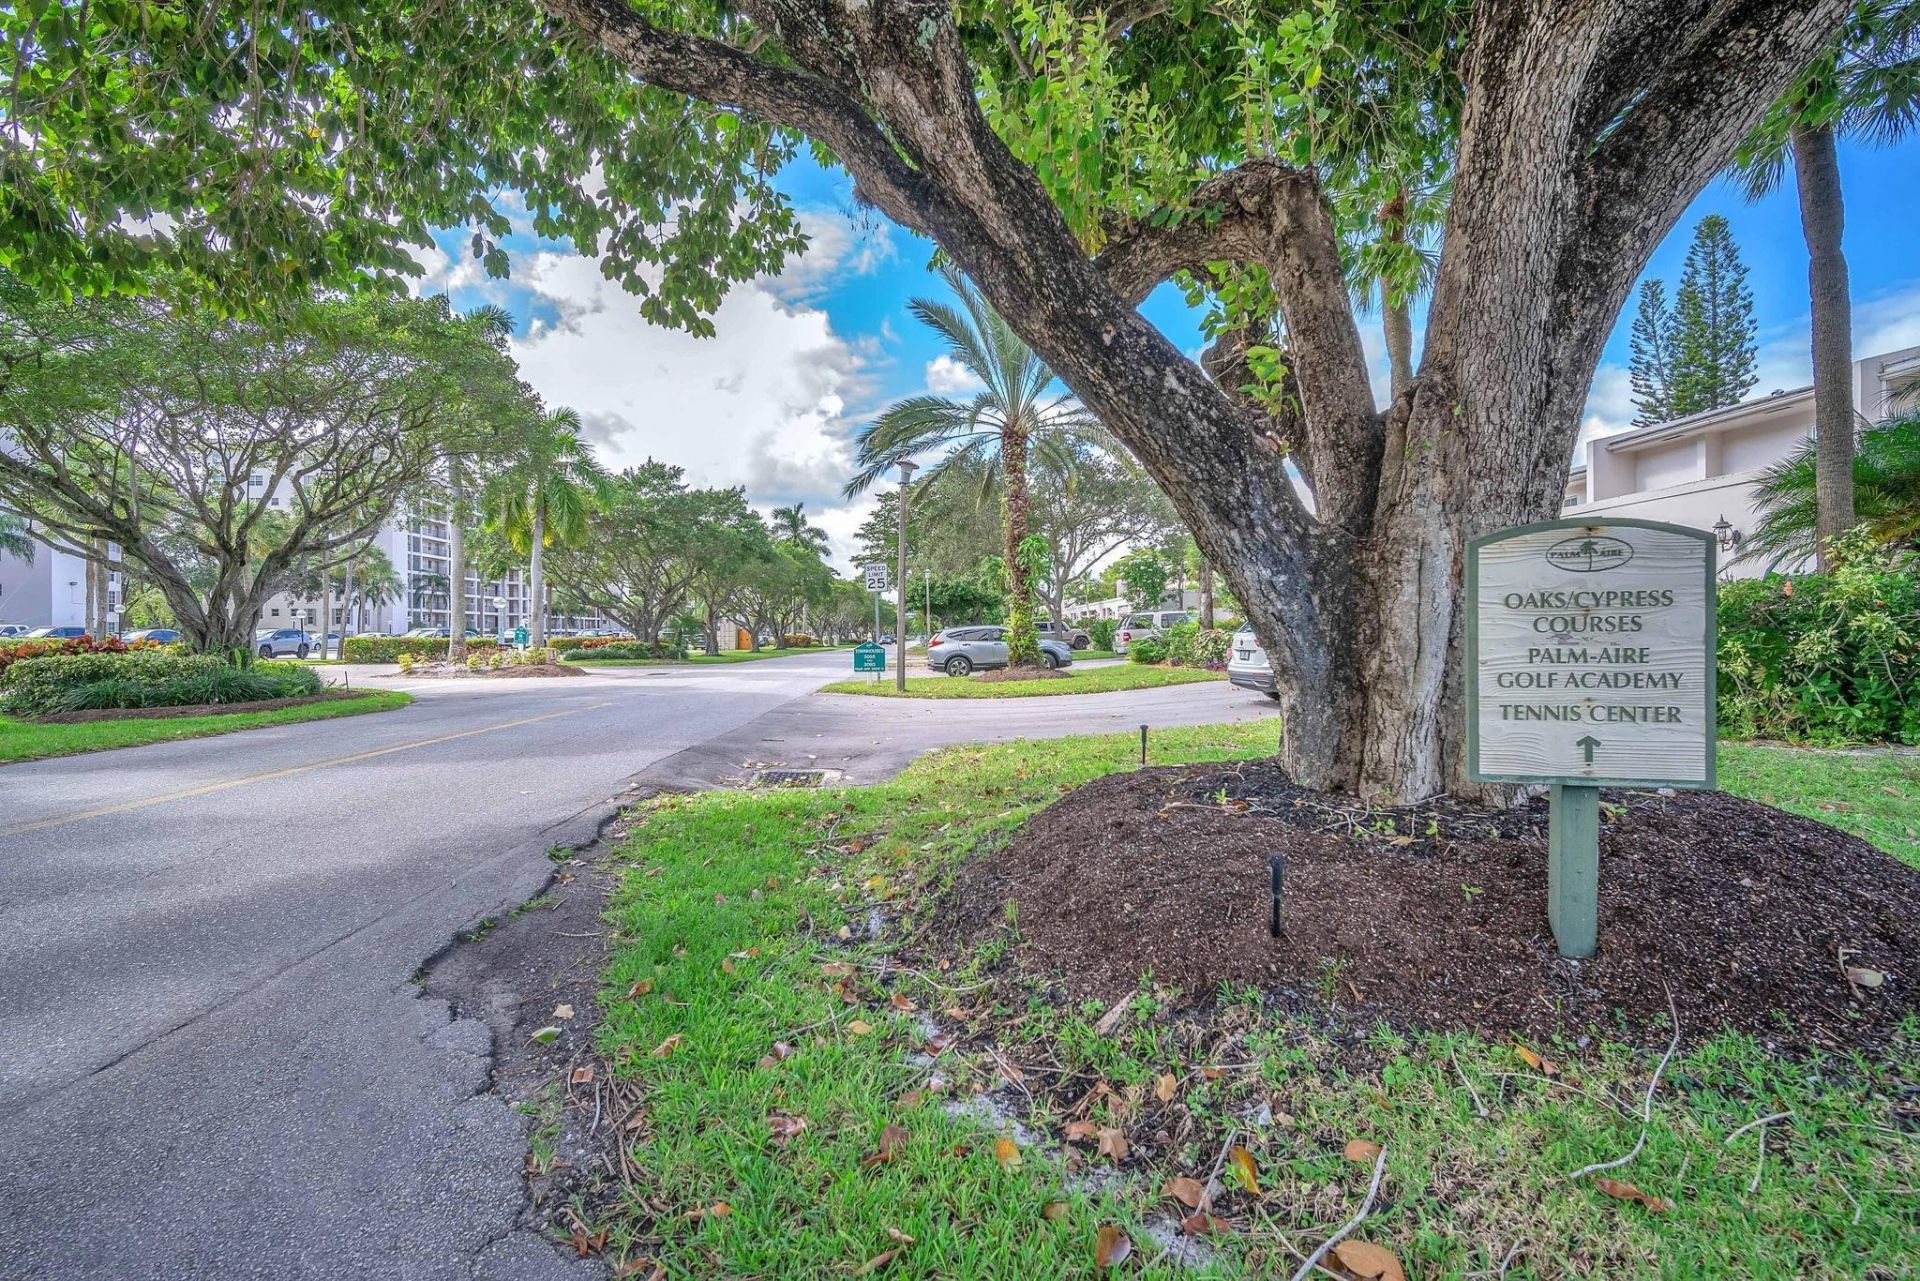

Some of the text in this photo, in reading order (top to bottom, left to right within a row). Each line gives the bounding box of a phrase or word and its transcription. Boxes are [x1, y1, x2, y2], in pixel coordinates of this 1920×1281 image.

[1550, 549, 1624, 559] PALM AIRE
[867, 577, 886, 589] 25
[1503, 589, 1674, 610] OAKS/CYPRESS
[1533, 615, 1643, 633] COURSES
[1528, 647, 1650, 664] PALM-AIRE
[1497, 672, 1684, 689] GOLF ACADEMY
[1499, 704, 1683, 723] TENNIS CENTER
